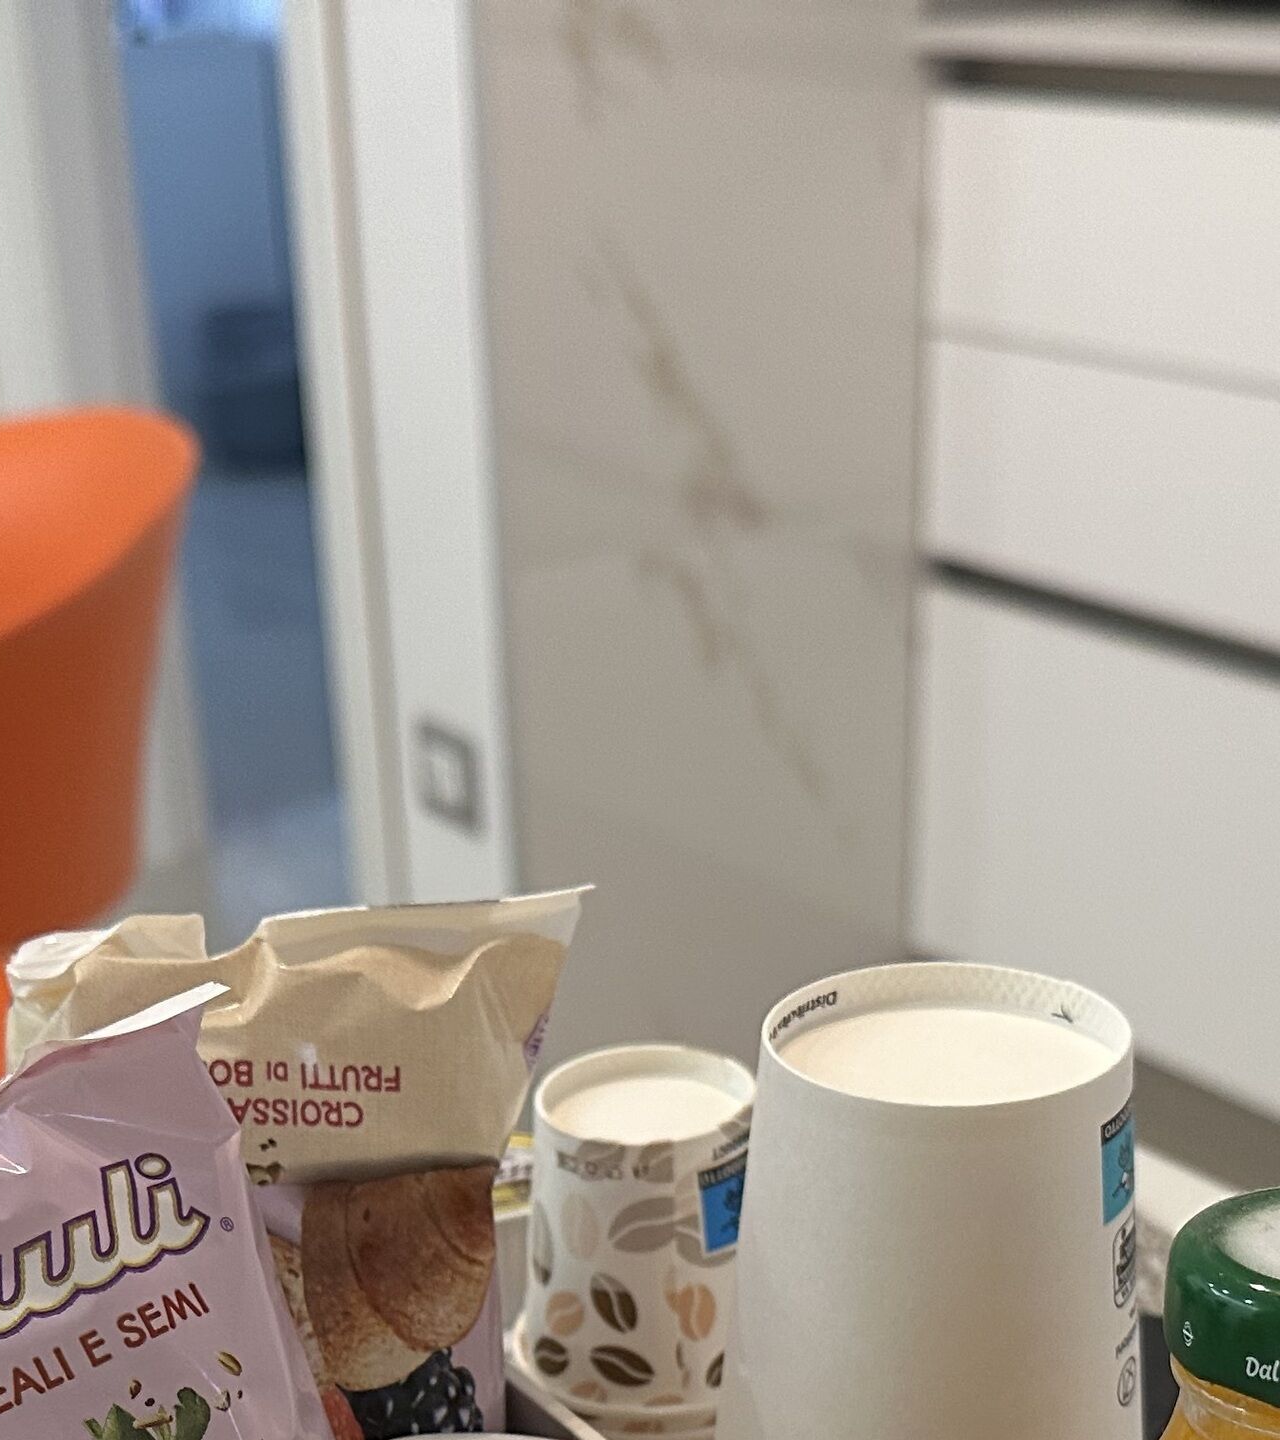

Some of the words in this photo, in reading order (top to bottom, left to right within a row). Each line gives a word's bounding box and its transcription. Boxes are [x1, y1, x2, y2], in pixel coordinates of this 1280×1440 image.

[208, 1059, 254, 1087] BO
[266, 1060, 289, 1082] DI
[300, 1062, 401, 1092] FRUTTI
[227, 1097, 365, 1128] CROISSA
[77, 1328, 113, 1368] E
[115, 1282, 211, 1349] SEMI
[1244, 1355, 1280, 1383] Dal
